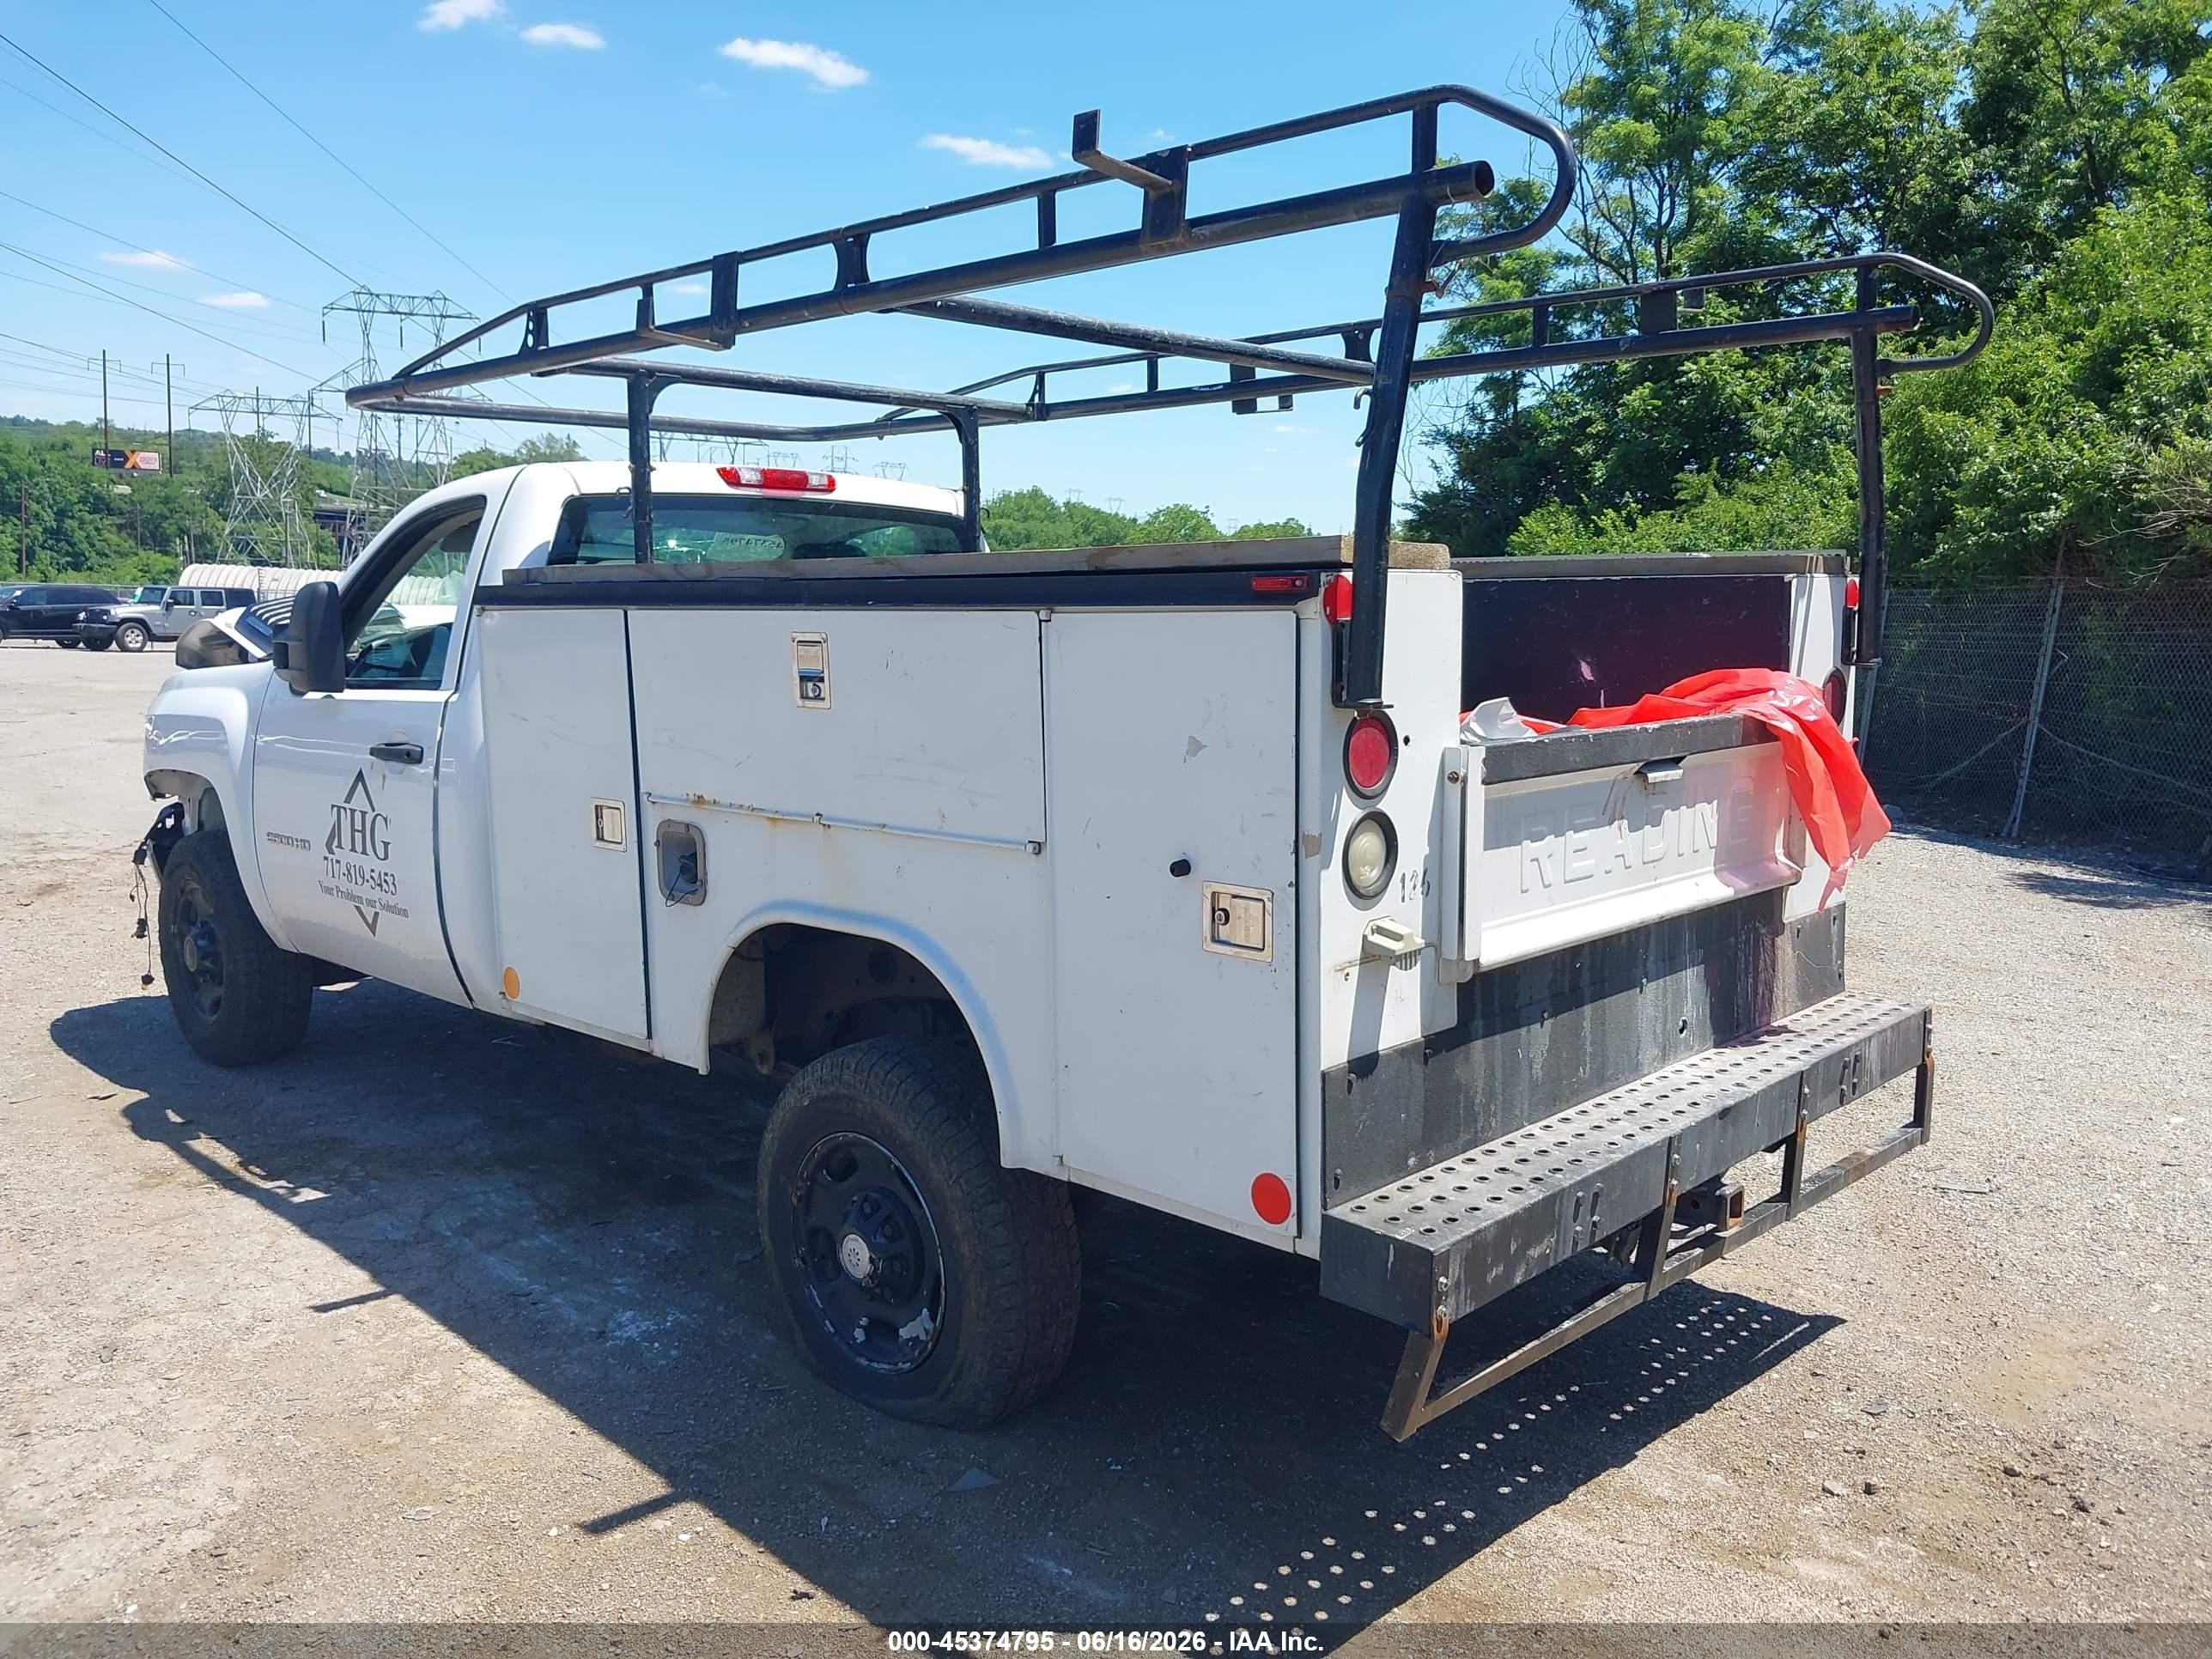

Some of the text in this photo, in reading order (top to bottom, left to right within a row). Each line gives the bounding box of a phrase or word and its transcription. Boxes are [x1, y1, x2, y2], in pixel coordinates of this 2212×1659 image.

[331, 804, 392, 860] THG
[324, 855, 398, 896] 717-819-5453
[319, 879, 410, 919] Your Problem our Solution
